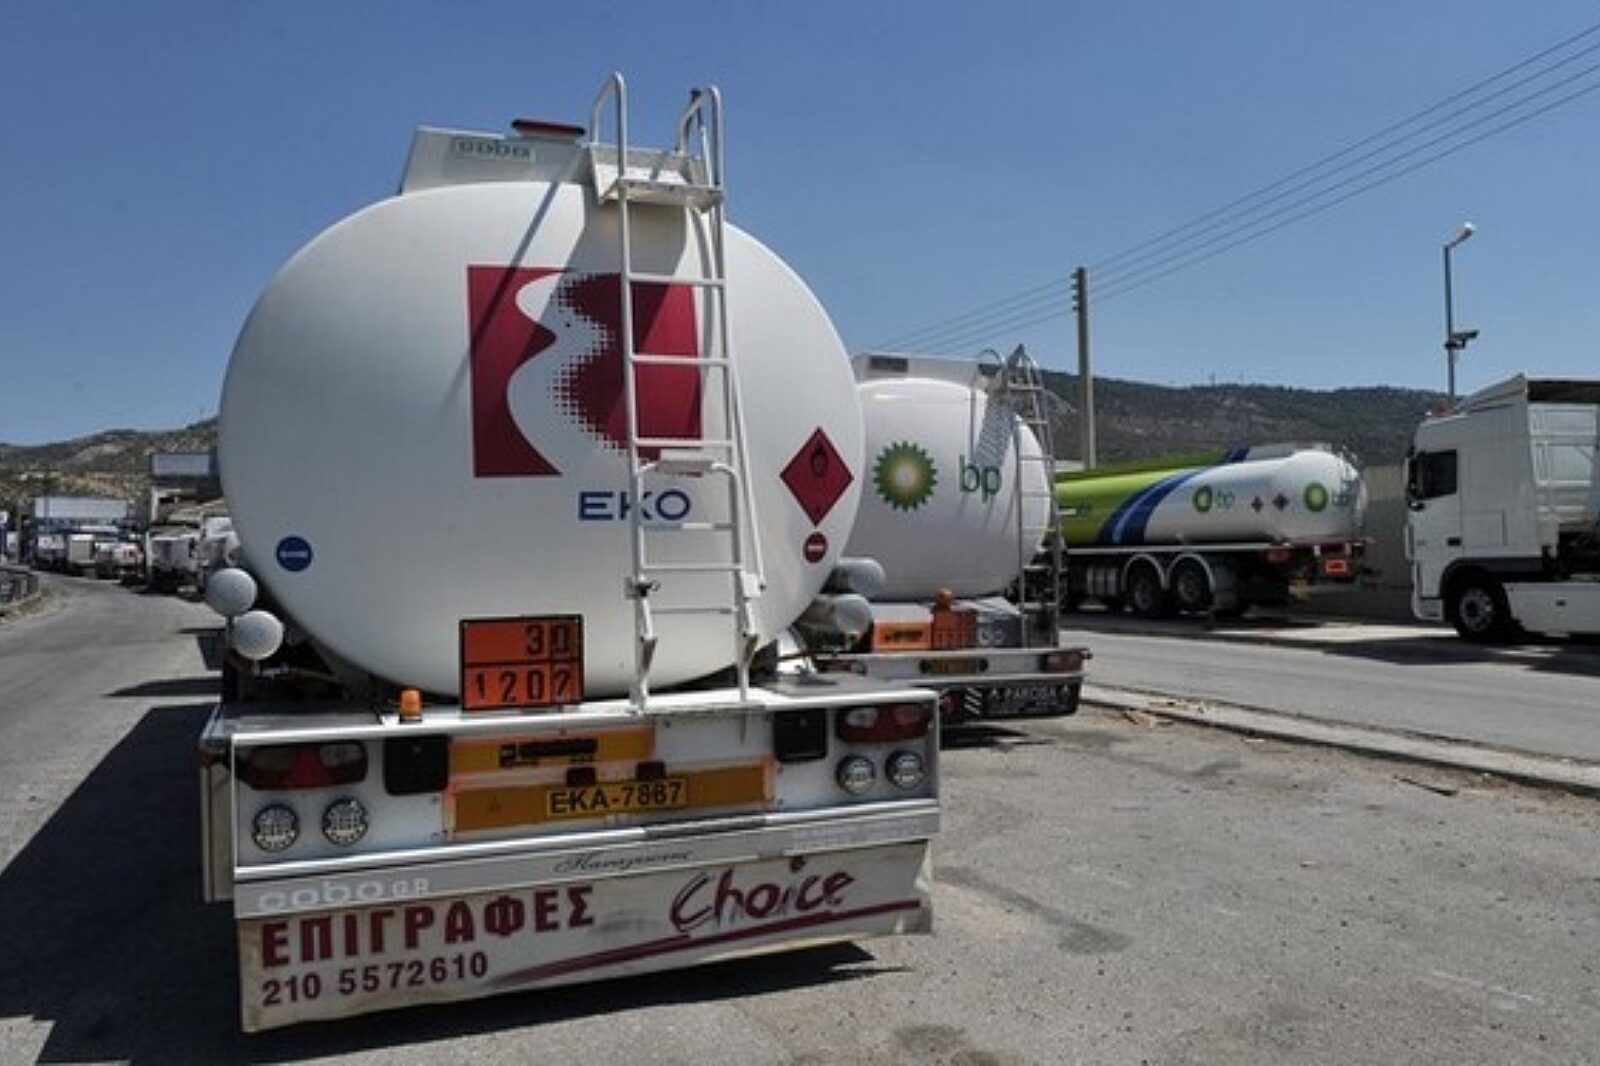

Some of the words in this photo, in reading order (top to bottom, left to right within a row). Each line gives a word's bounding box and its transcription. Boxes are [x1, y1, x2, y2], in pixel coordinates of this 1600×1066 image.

[578, 489, 691, 521] EKO
[958, 455, 1001, 503] bp
[670, 855, 856, 934] Choice
[262, 886, 593, 968] ΕΠΙΓΡΑΦΕΣ
[262, 975, 321, 1007] 210
[338, 951, 488, 995] 5572610
